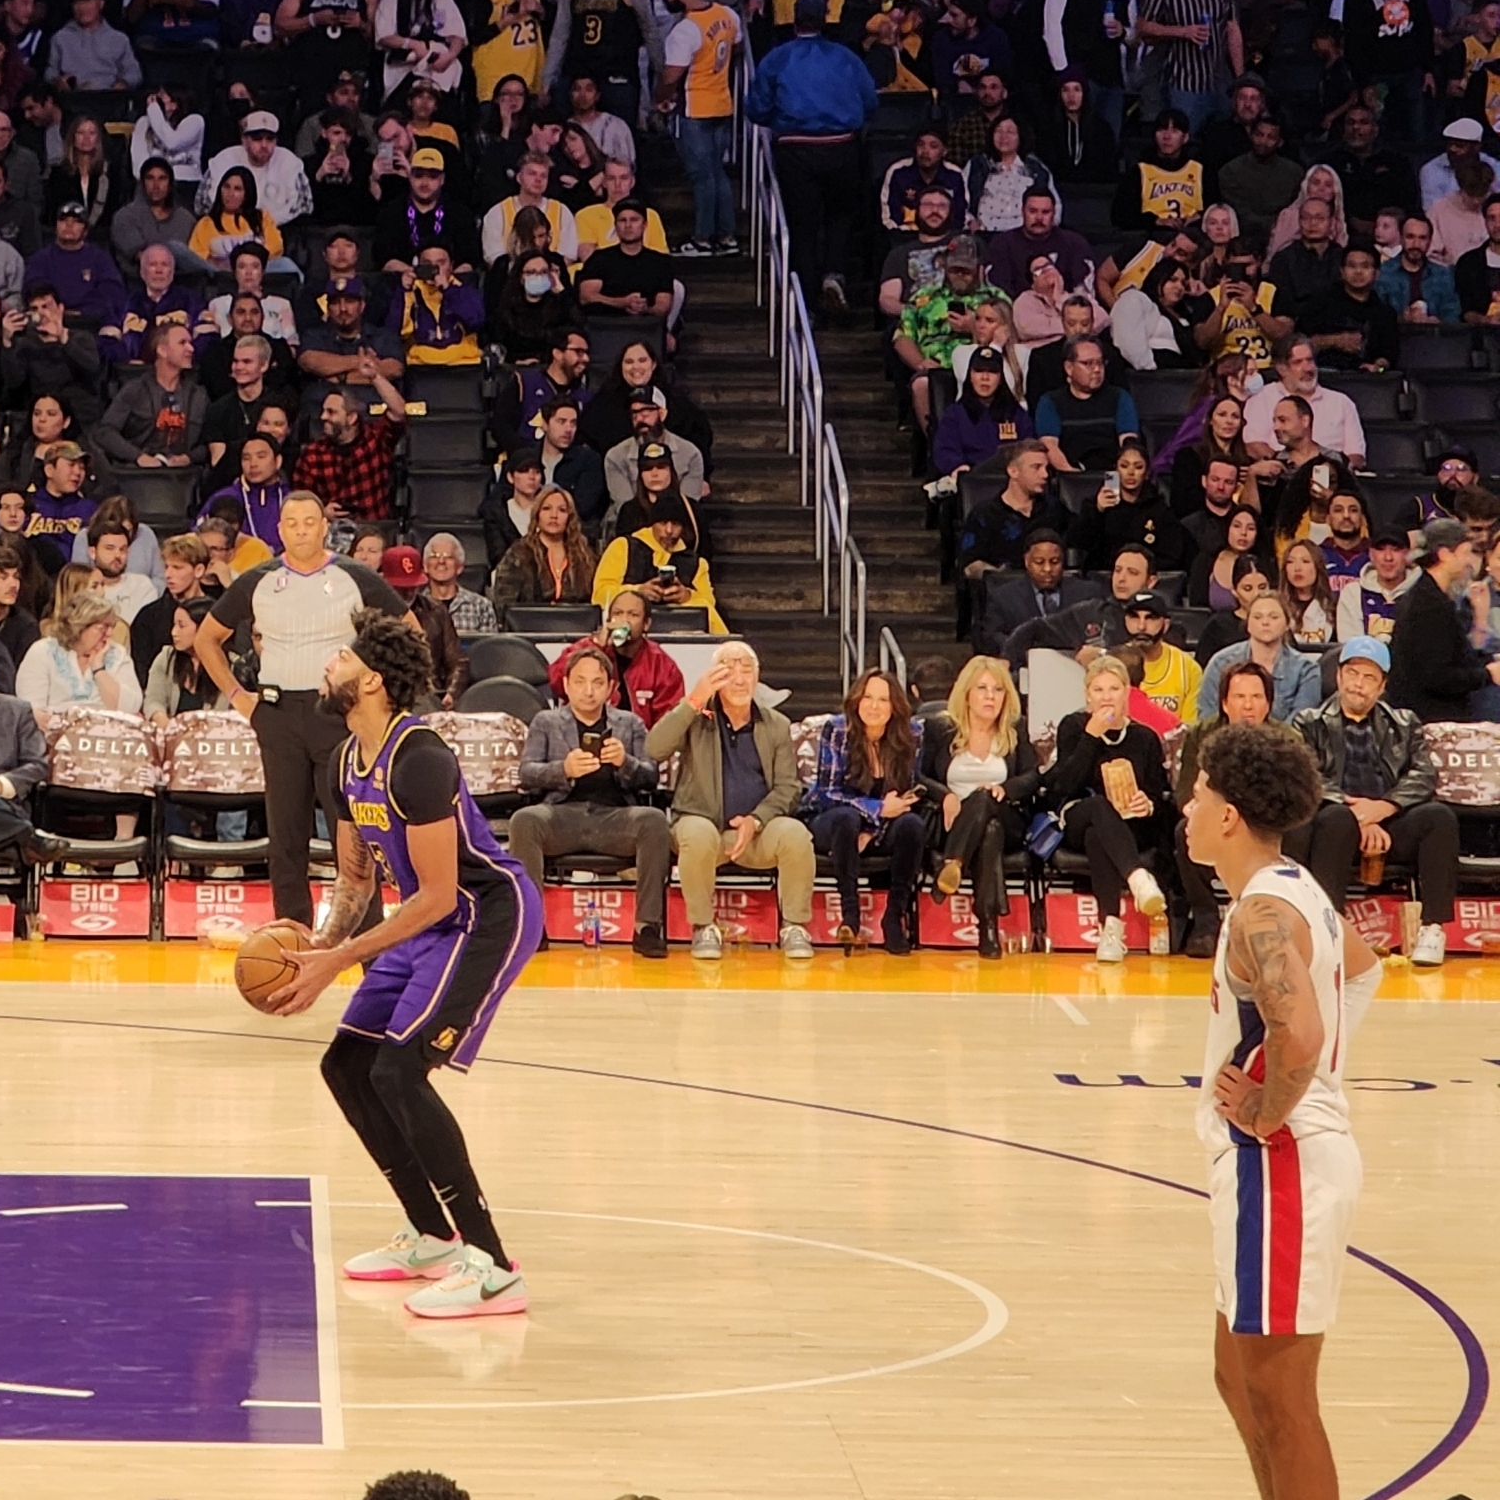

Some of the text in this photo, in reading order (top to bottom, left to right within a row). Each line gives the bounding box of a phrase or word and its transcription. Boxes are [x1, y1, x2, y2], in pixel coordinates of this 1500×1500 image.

[510, 19, 538, 47] 23
[583, 14, 602, 45] 3
[1150, 181, 1194, 199] LAKERS
[1235, 337, 1268, 360] 23
[28, 512, 82, 538] LAKERS
[79, 737, 149, 757] DELTA
[197, 738, 258, 757] DELT
[70, 883, 118, 902] BIO
[195, 883, 244, 903] BIO
[573, 890, 621, 908] BIO
[71, 902, 117, 913] STEEL
[196, 903, 243, 914] STEEL
